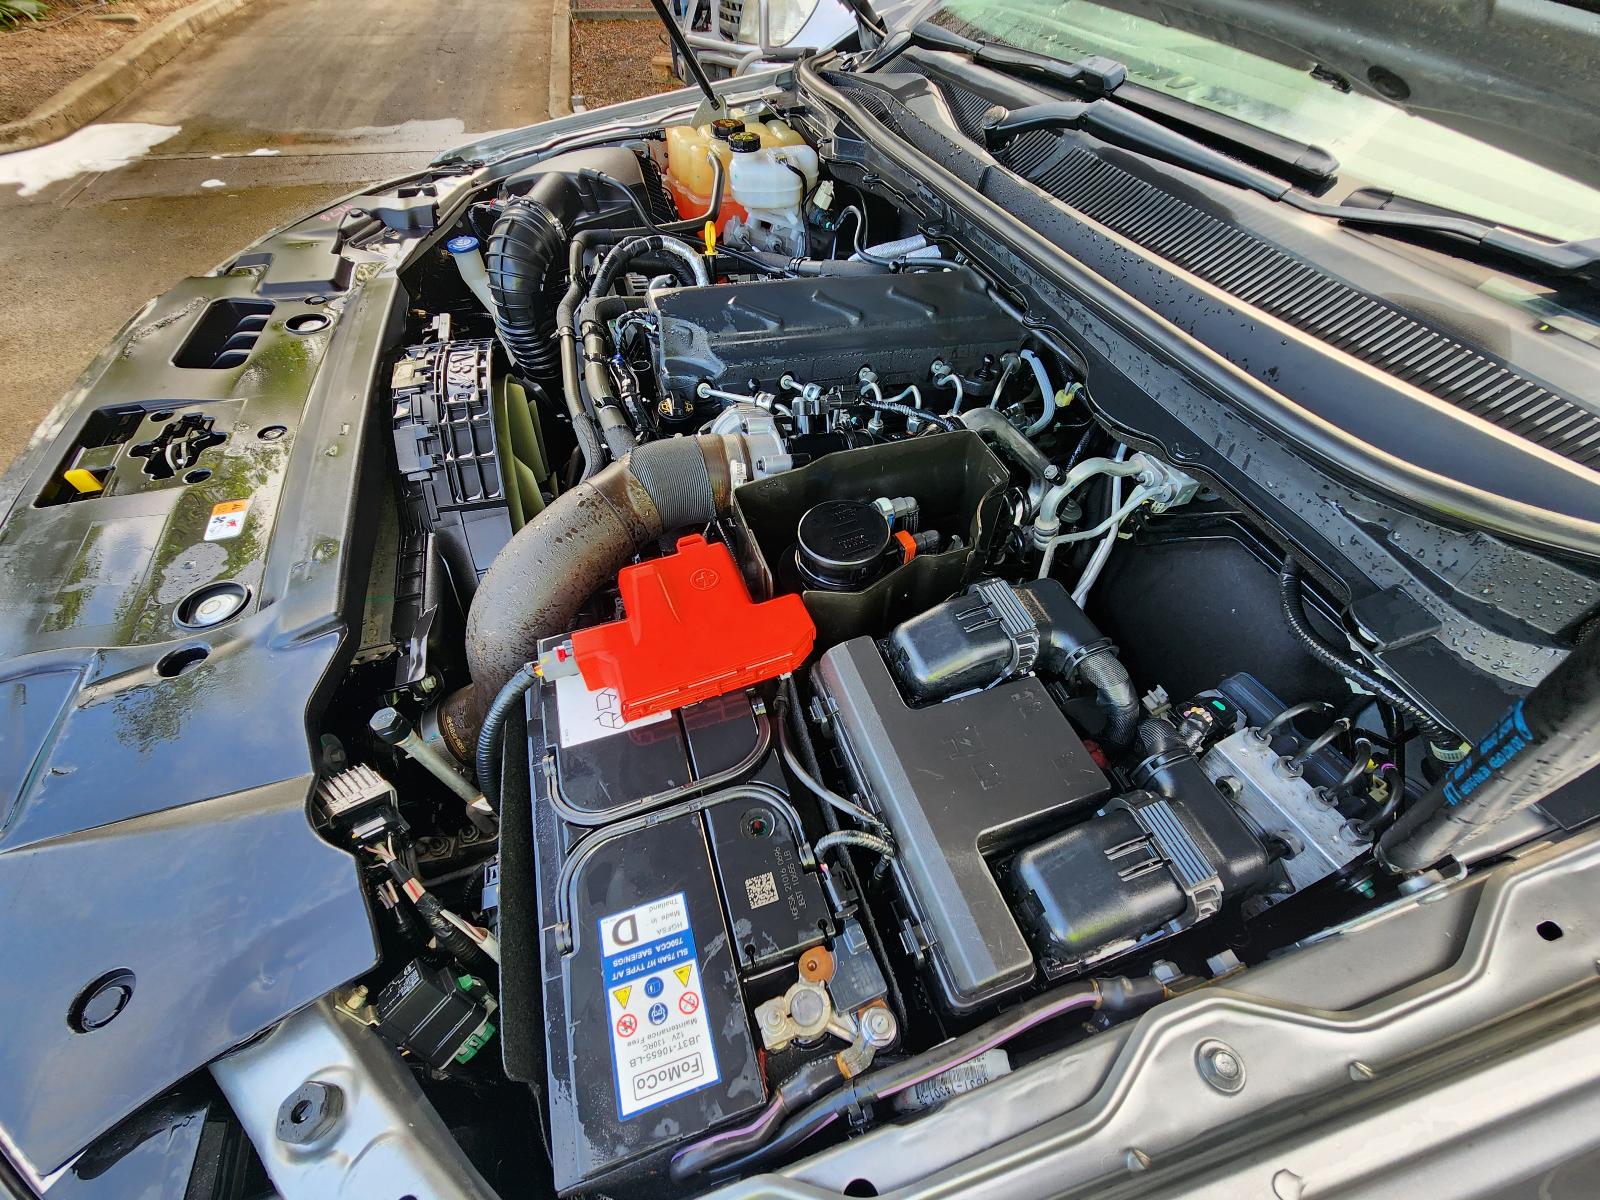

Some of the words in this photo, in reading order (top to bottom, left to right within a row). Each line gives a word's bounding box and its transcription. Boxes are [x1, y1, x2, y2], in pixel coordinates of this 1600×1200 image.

[648, 897, 679, 913] Thailand
[661, 909, 681, 921] Made
[611, 913, 640, 948] D
[675, 947, 689, 960] SLI
[611, 970, 625, 981] A/T
[626, 963, 646, 976] TYPE
[647, 1017, 698, 1040] Maintenance
[626, 1037, 646, 1047] Free
[671, 1031, 684, 1041] 12V
[636, 1057, 701, 1090] FoMoCo
